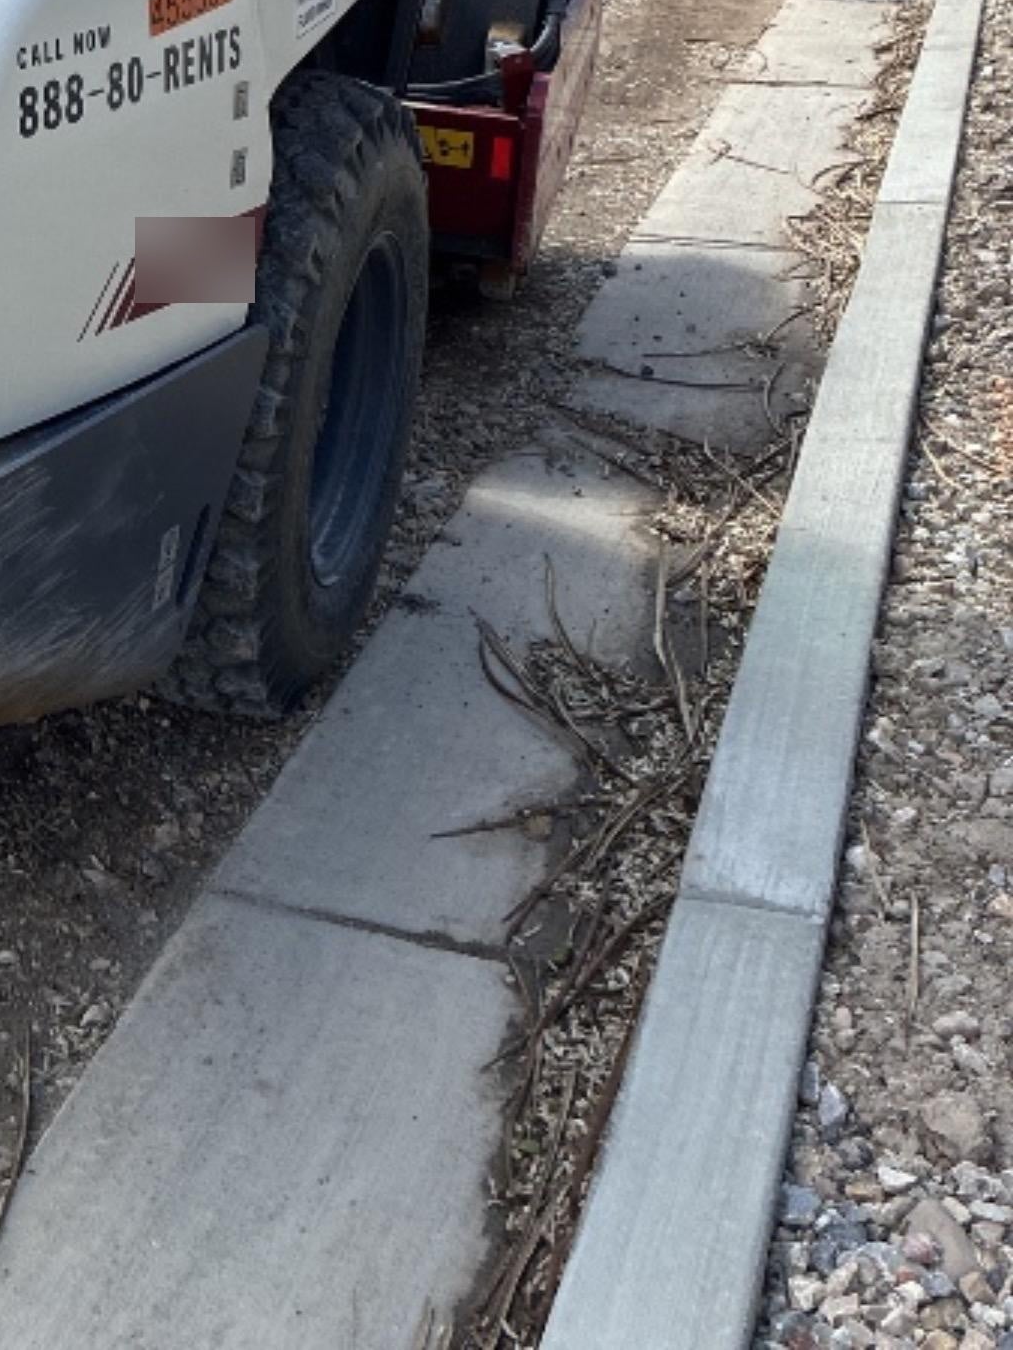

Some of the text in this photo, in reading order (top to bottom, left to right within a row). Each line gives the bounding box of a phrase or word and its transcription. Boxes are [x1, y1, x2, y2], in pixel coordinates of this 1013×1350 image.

[16, 23, 111, 70] CALL NOW
[19, 25, 241, 139] 888-80-RENTS
